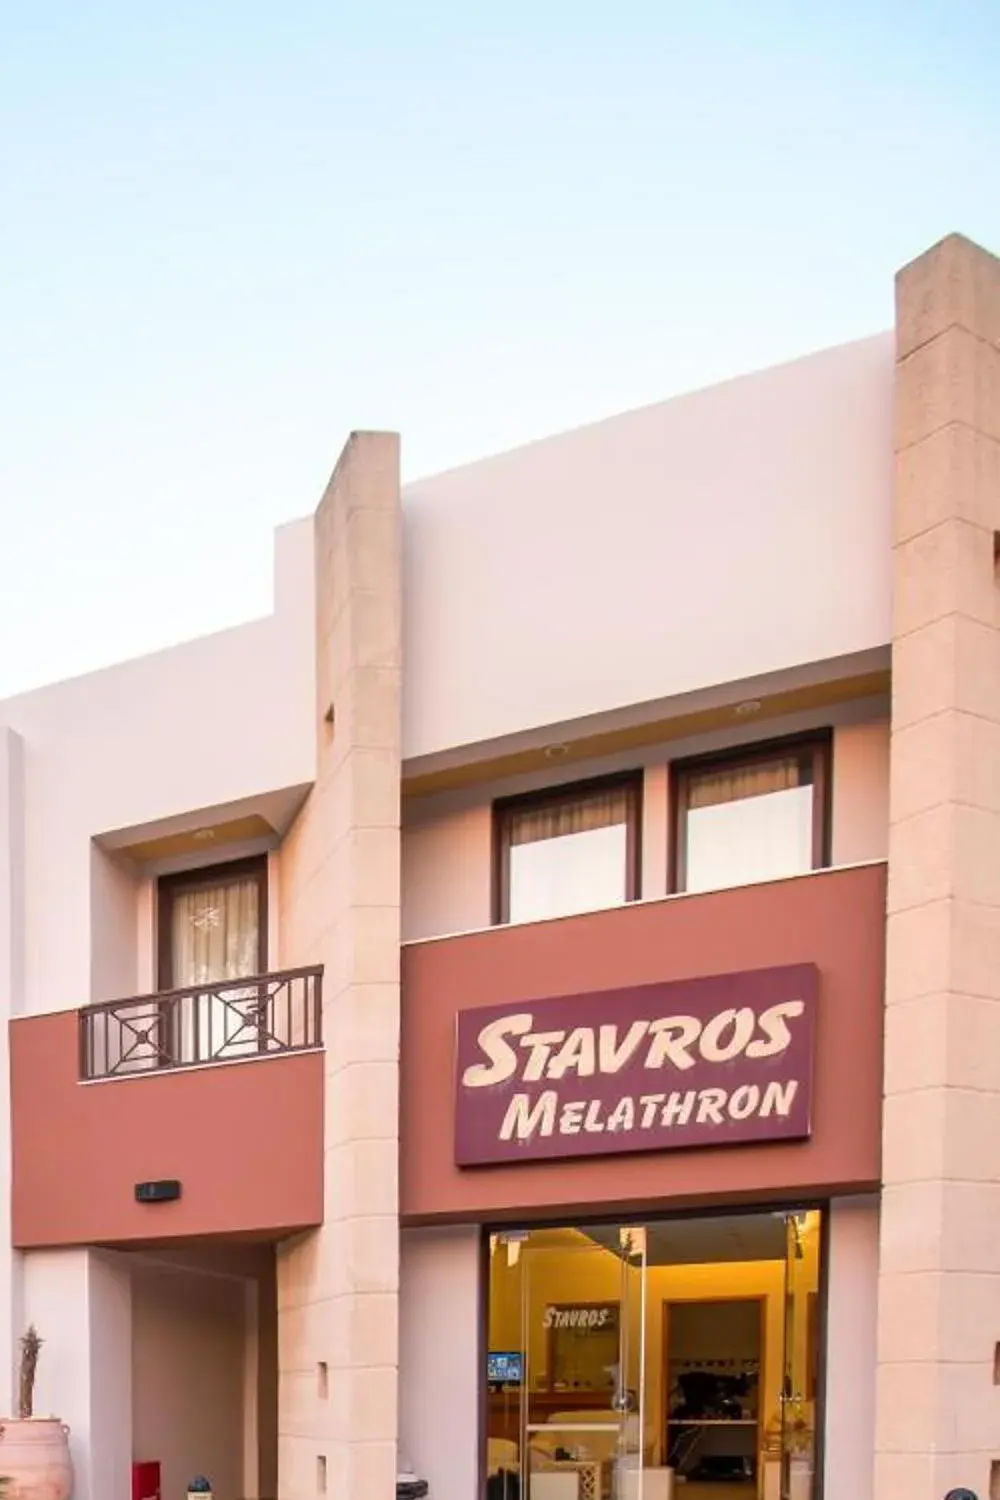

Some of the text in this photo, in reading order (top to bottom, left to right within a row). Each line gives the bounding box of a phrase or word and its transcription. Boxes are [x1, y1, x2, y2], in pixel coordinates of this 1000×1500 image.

[462, 1001, 805, 1087] STAVROS
[498, 1080, 798, 1140] MELATHRON
[542, 1306, 608, 1328] STAVROS
